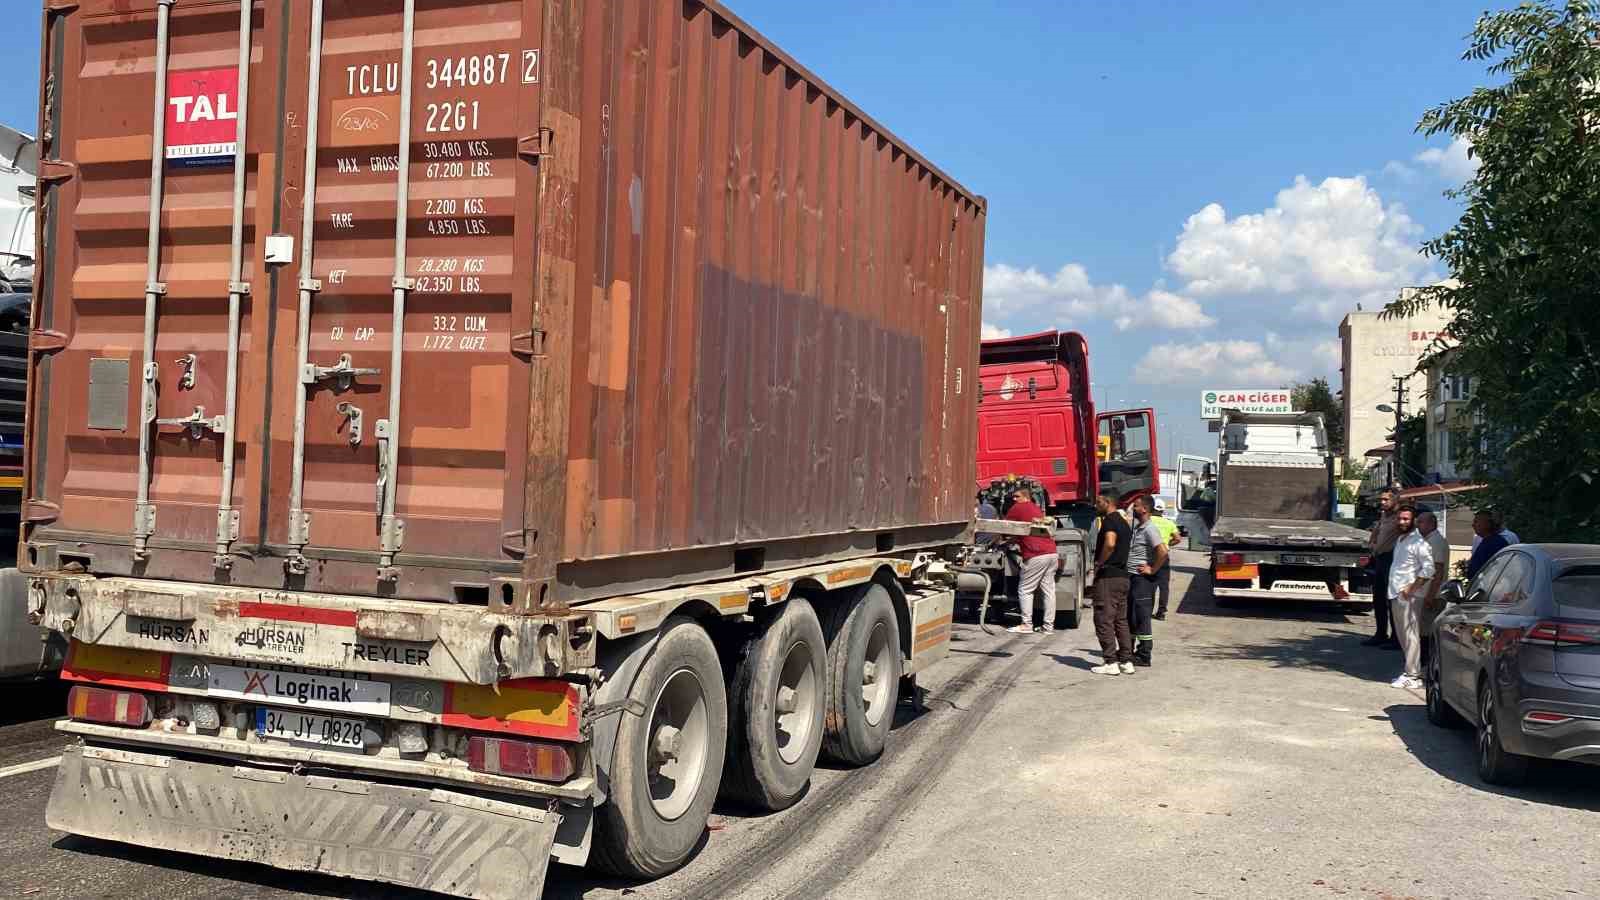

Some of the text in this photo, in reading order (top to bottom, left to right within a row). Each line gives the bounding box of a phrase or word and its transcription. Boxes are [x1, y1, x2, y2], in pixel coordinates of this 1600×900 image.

[346, 62, 399, 95] TCLU
[425, 53, 510, 89] 344887
[169, 93, 238, 123] TAL
[425, 100, 480, 132] 22G1
[423, 141, 493, 159] 30.480 KGS.
[337, 155, 400, 173] MAX. GROSS
[470, 161, 494, 177] LBS.
[463, 198, 487, 214] KGS.
[331, 213, 355, 229] TARE
[464, 218, 490, 235] LBS.
[463, 258, 486, 273] KGS.
[328, 269, 347, 284] NET
[460, 276, 484, 292] LBS.
[432, 315, 457, 331] 33.2
[330, 326, 375, 341] CU. CAP.
[1218, 391, 1288, 403] CAN CİĞER
[139, 620, 210, 645] HÜRSAN
[245, 626, 305, 647] HÜRSAN
[267, 643, 305, 655] TREYLER
[341, 641, 431, 667] TREYLER
[275, 674, 352, 704] Loginak
[267, 712, 285, 735] 34
[294, 715, 315, 741] JY
[322, 719, 363, 746] 0828
